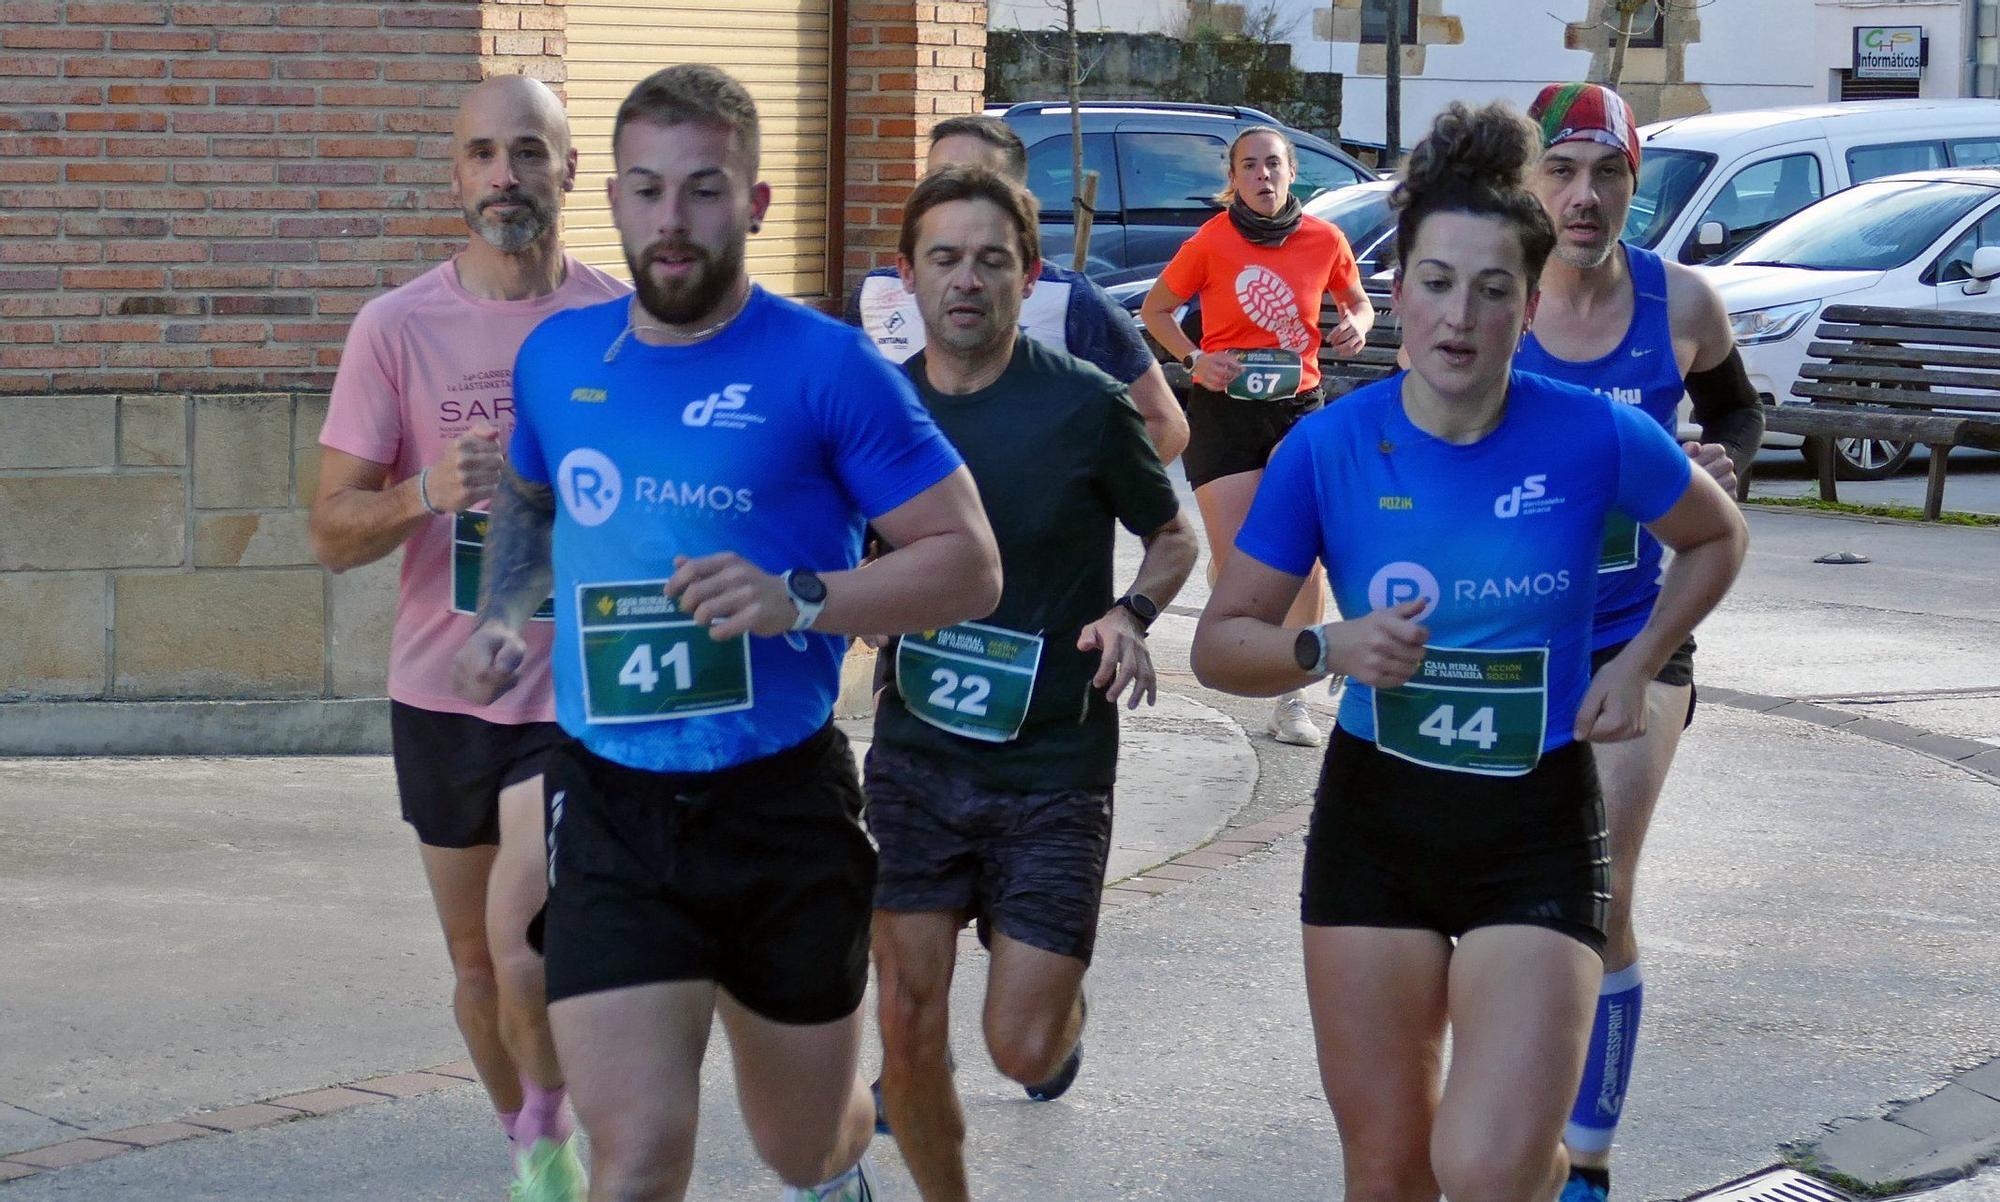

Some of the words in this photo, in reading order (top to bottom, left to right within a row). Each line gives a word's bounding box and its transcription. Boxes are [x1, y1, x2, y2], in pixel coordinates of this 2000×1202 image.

[1247, 373, 1281, 394] 67
[634, 476, 753, 512] RAMOS
[1455, 569, 1570, 601] RAMOS
[618, 641, 692, 693] 41
[1424, 661, 1447, 670] CAJA
[1448, 663, 1480, 672] RURAL
[1424, 668, 1436, 677] DE
[1439, 670, 1484, 680] NAVARRA
[1486, 672, 1521, 681] SOCIAL
[1487, 663, 1522, 672] ACCIÓN
[928, 668, 991, 717] 22
[1419, 705, 1498, 750] 44
[1601, 1003, 1623, 1098] COMPRESSPRINT
